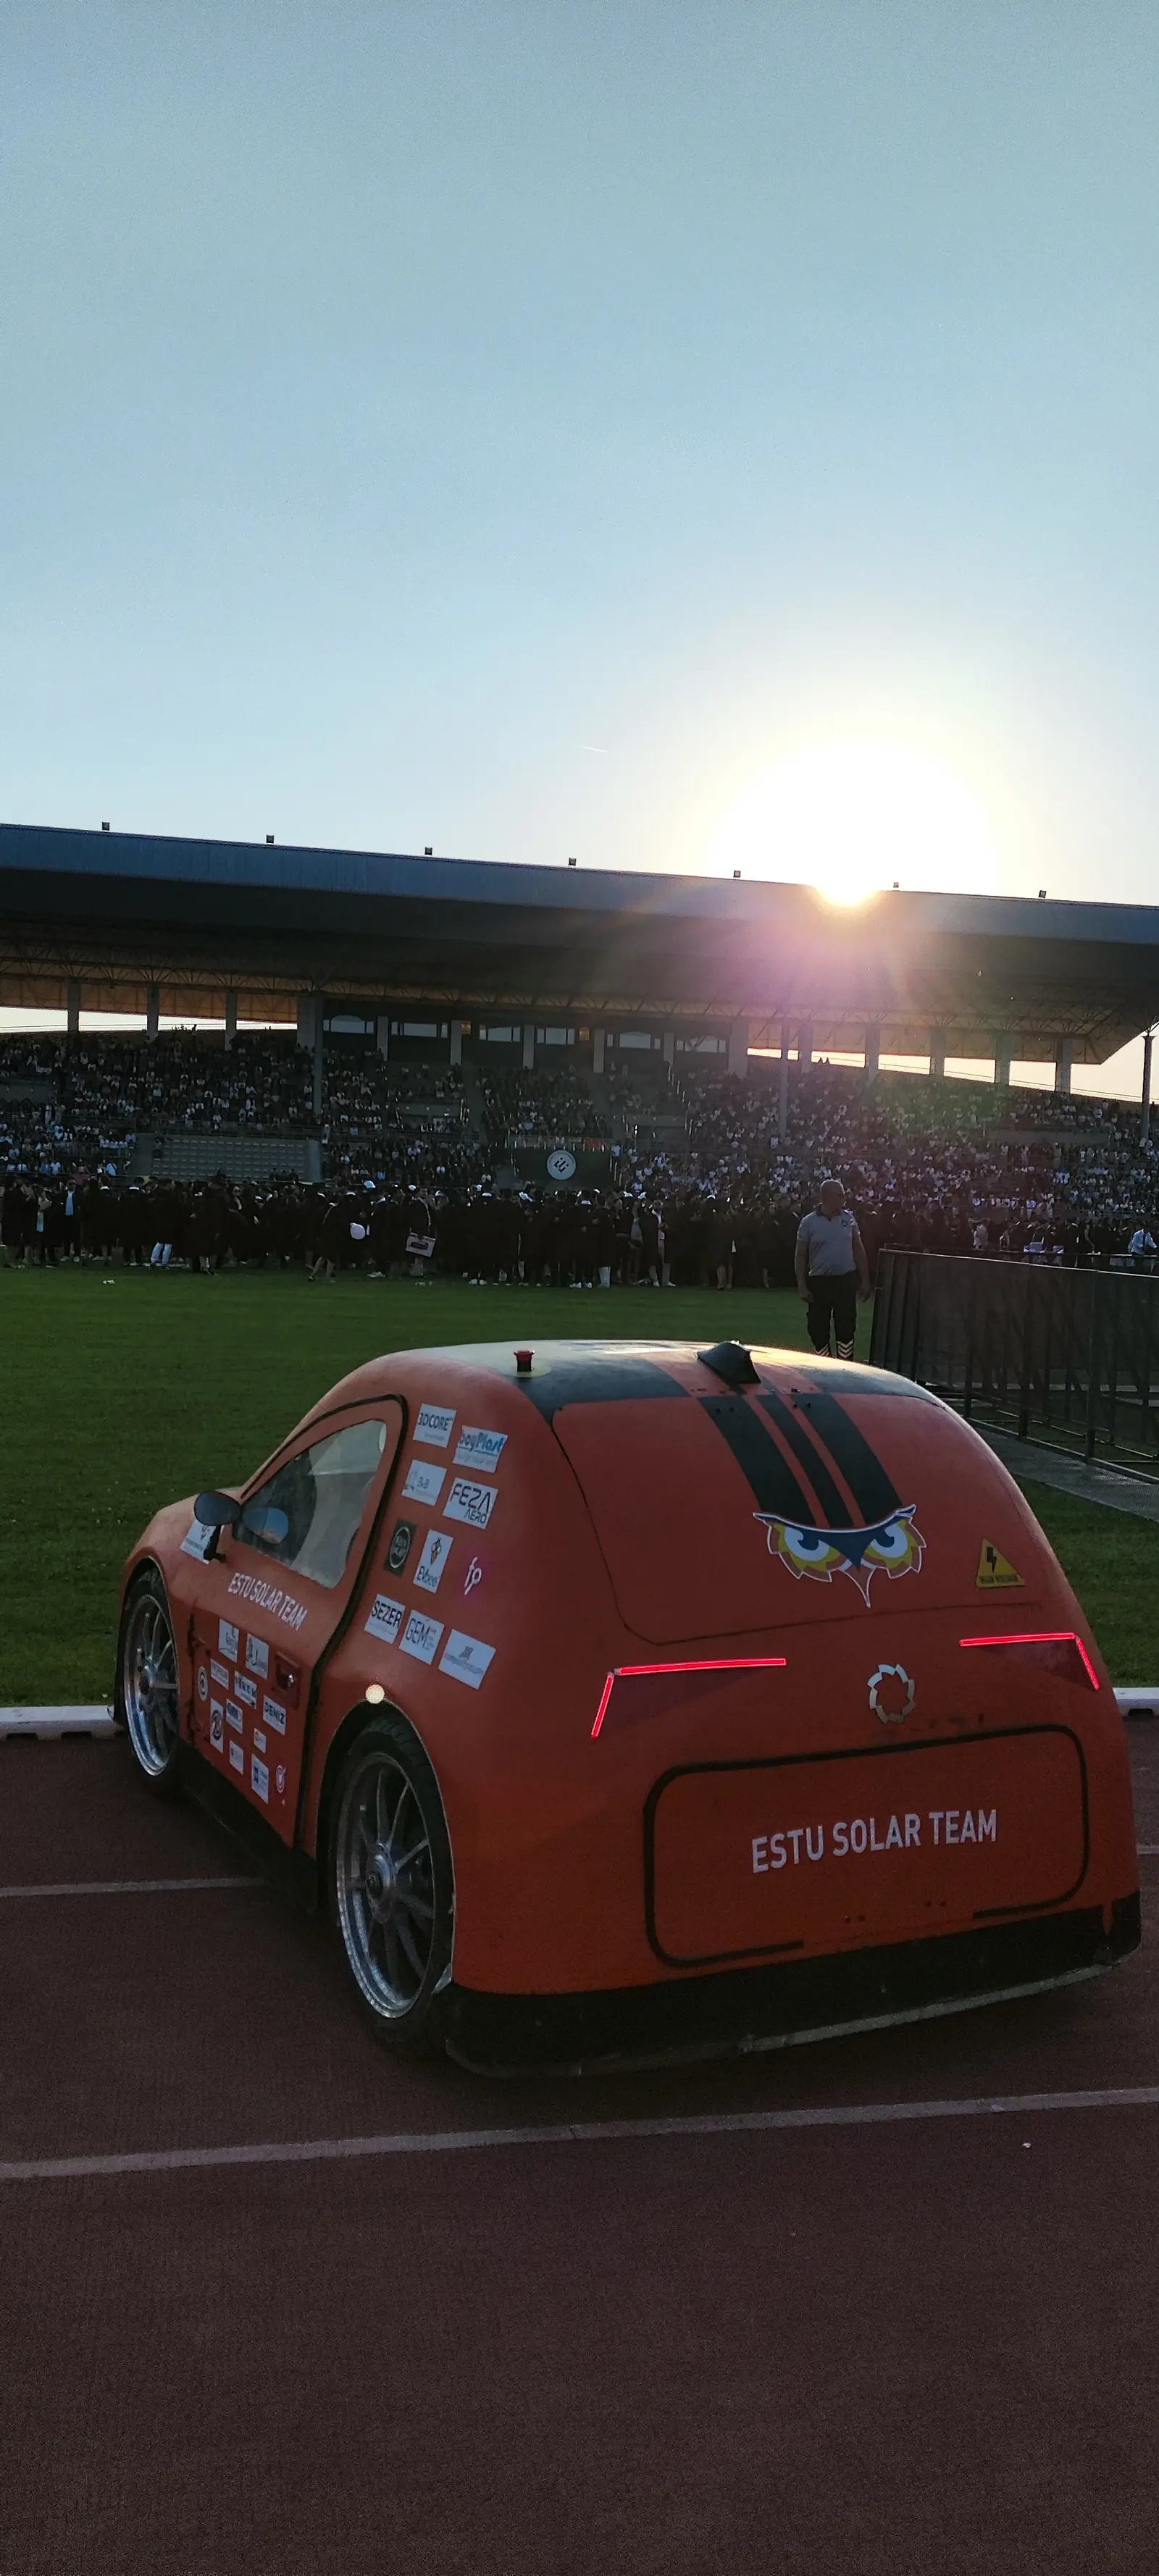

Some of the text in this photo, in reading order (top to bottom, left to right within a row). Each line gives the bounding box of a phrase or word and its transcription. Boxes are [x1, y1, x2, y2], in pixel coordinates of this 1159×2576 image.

[227, 1572, 308, 1632] ESTU SOLAR TEAM
[372, 1600, 403, 1629] SEZER
[752, 1809, 997, 1874] ESTU SOLAR TEAM
